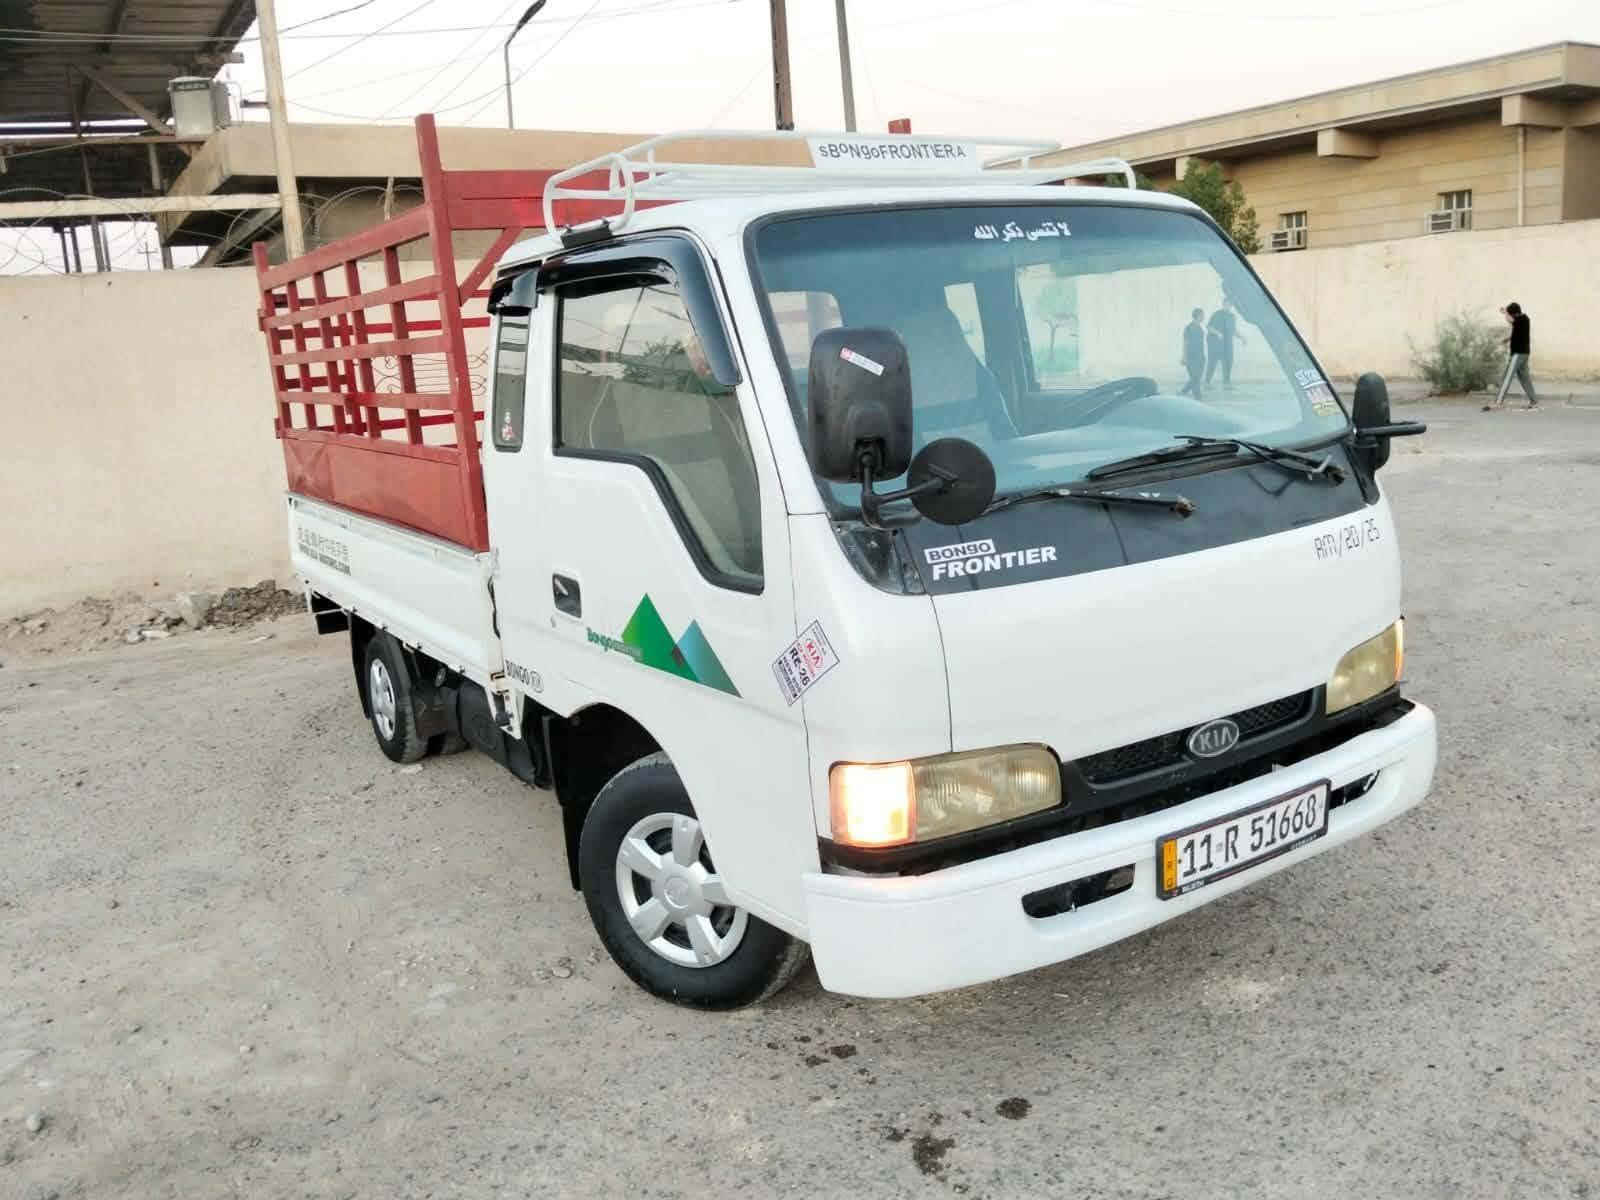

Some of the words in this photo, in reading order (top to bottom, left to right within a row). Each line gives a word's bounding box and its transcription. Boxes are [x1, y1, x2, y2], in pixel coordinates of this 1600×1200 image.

[974, 225, 999, 240] الله
[932, 546, 1058, 581] FRONTIER
[1199, 726, 1234, 752] KIA
[1182, 833, 1214, 878] 11
[1224, 824, 1239, 863] R
[1250, 794, 1316, 851] 51668
